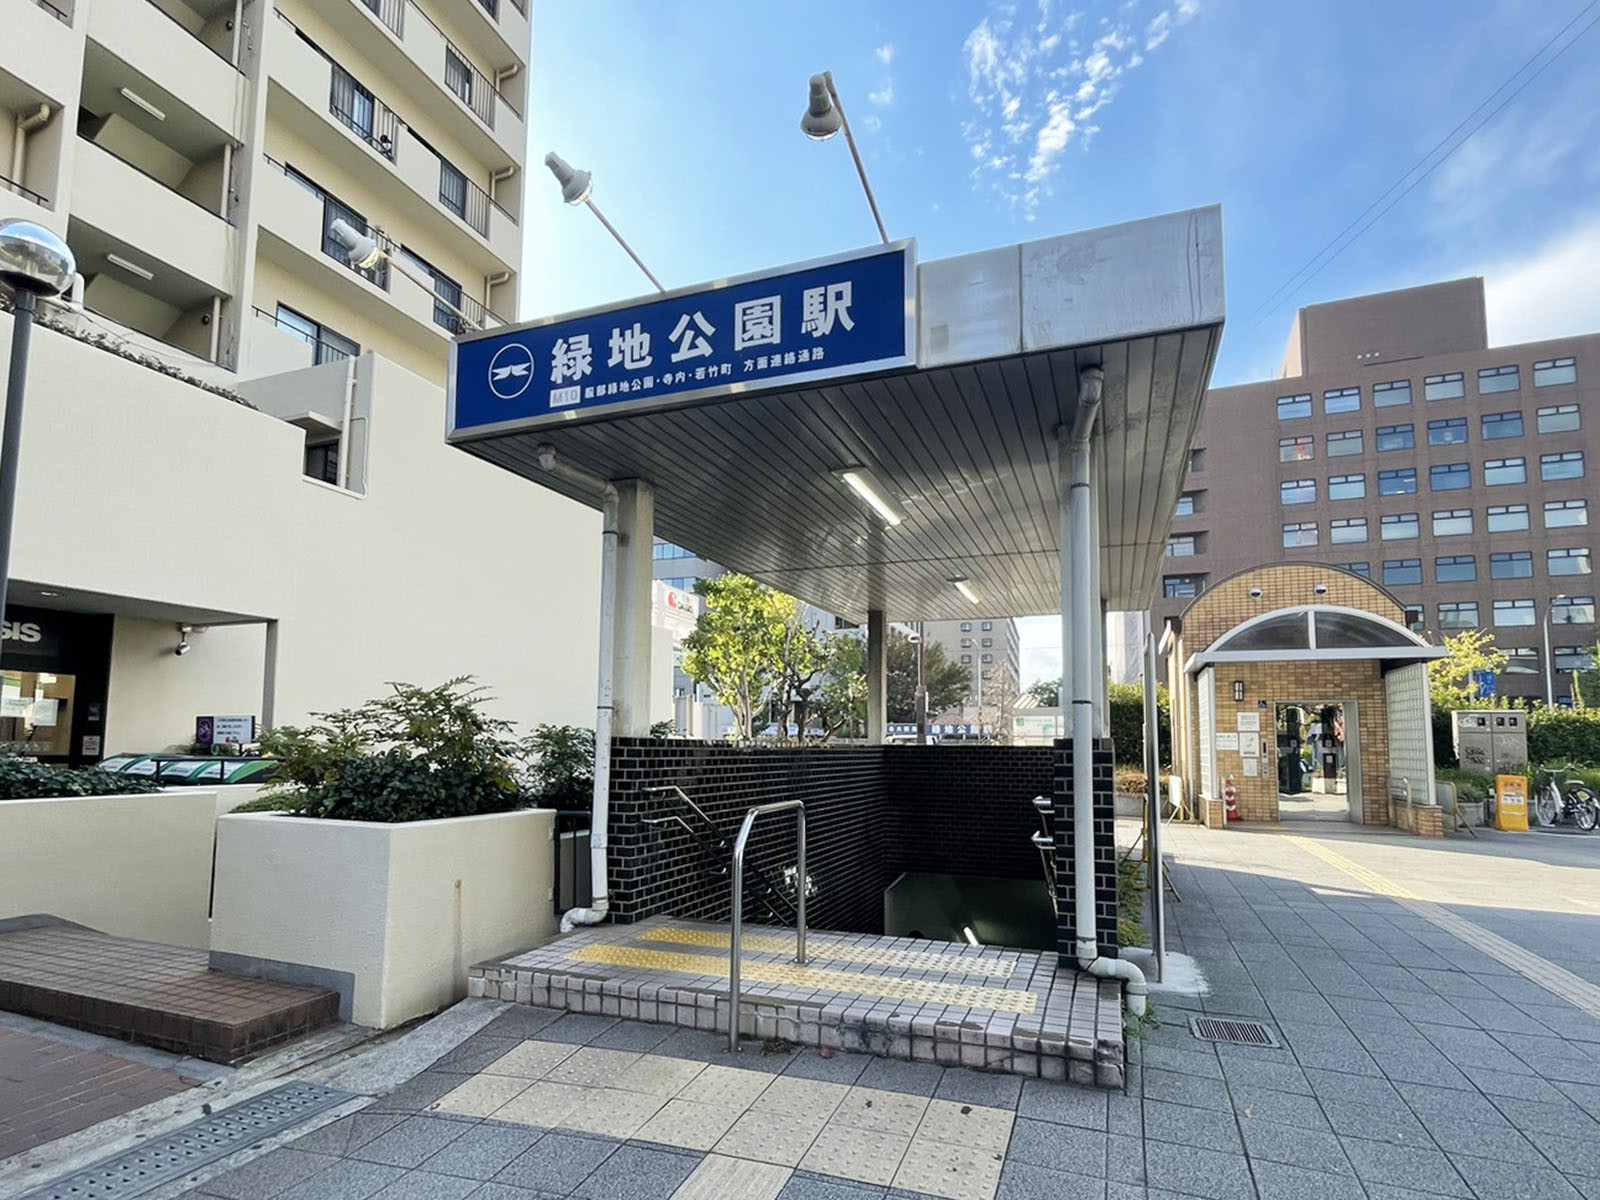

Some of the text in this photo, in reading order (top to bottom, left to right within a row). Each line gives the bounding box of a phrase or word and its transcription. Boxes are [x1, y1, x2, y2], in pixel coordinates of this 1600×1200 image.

[550, 281, 855, 384] 緑地公園駅
